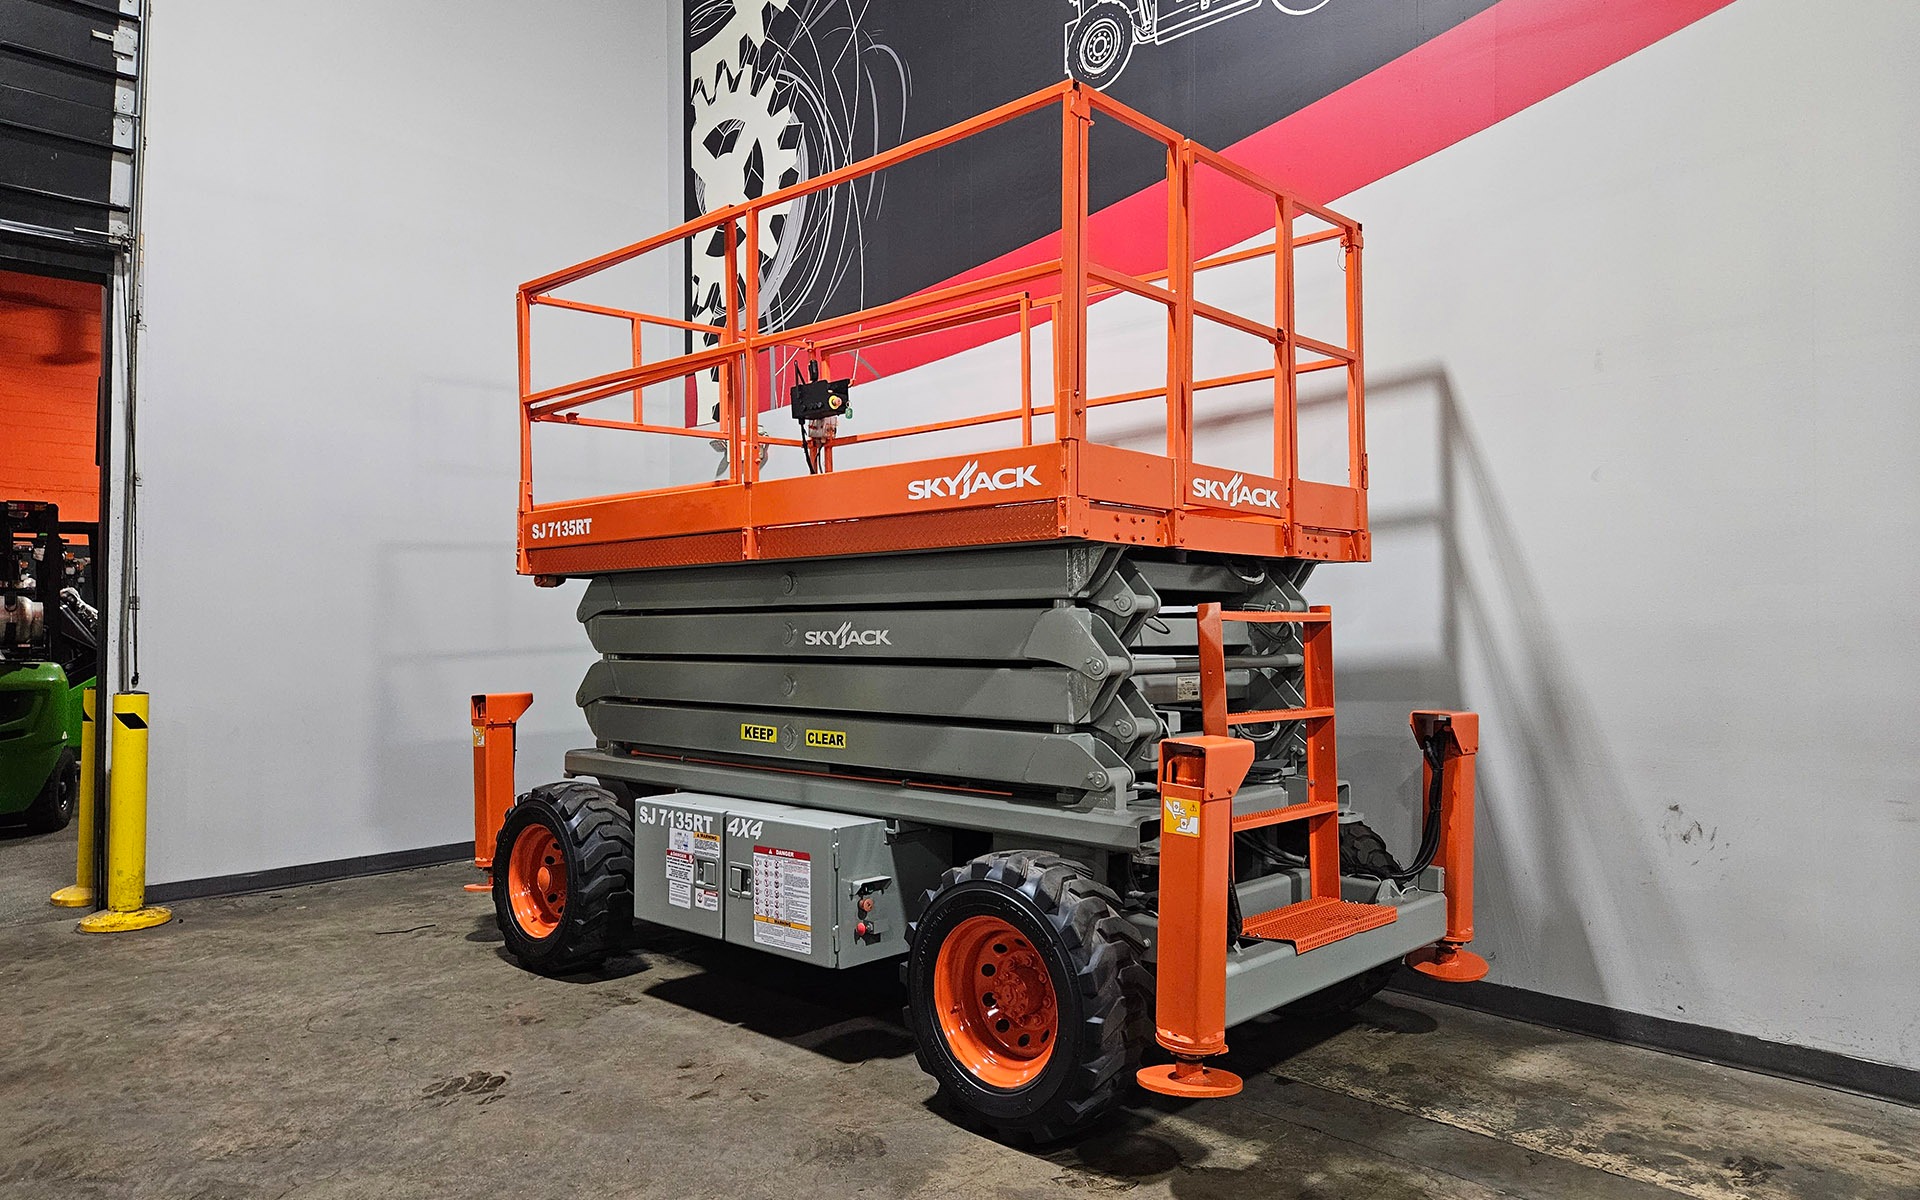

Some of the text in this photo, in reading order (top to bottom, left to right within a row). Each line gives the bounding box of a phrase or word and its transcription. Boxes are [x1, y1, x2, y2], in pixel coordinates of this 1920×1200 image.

[907, 460, 1042, 500] SKYJACK
[1192, 472, 1280, 509] SKYJACK
[532, 518, 592, 539] SJ 7135RT
[804, 621, 892, 649] SKYJACK
[744, 726, 774, 741] KEEP
[807, 732, 845, 747] CLEAR
[639, 806, 713, 833] SJ 7135RT
[726, 817, 764, 840] 4X4
[775, 849, 795, 858] DANGER
